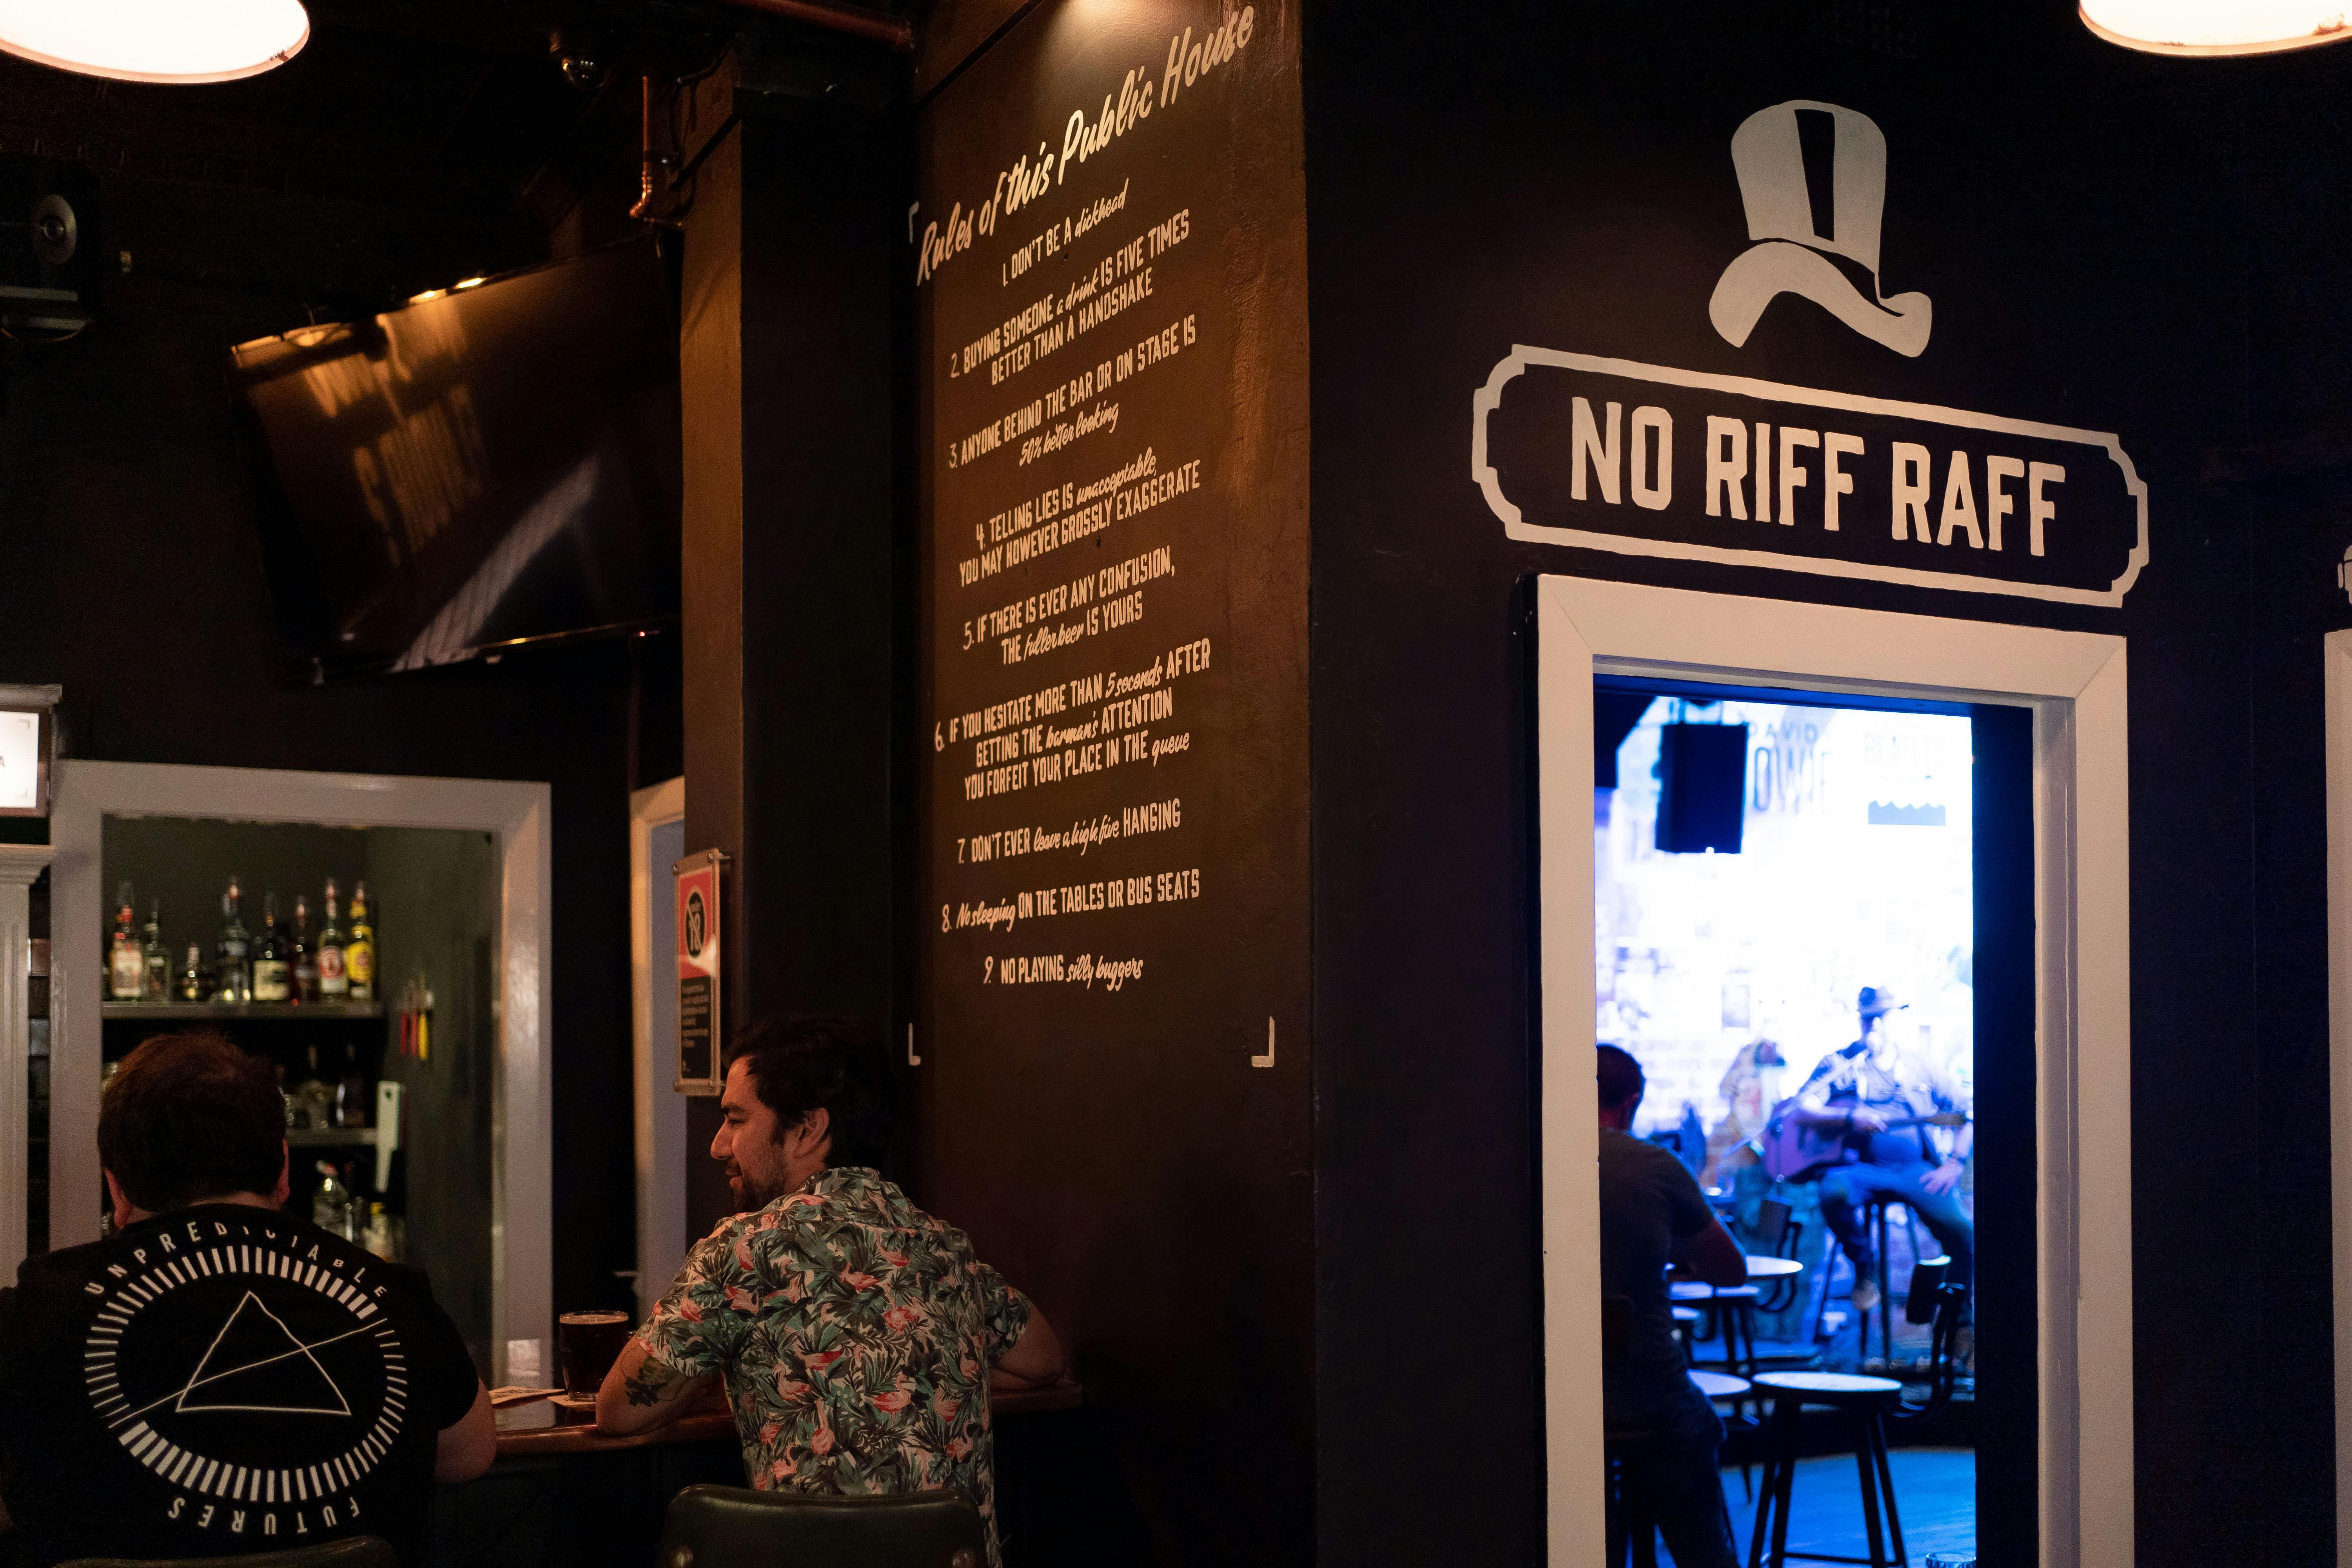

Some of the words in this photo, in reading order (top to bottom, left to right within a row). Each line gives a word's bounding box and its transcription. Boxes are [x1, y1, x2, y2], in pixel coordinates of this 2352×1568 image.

[916, 201, 974, 286] Rules
[978, 171, 1007, 236] of
[1005, 141, 1054, 215] this
[1058, 66, 1152, 185] Public
[1160, 5, 1254, 108] House
[1011, 234, 1044, 279] DON'T
[1046, 223, 1060, 256] BE
[1063, 216, 1071, 245] A
[1074, 177, 1129, 238] dickhead
[963, 327, 1000, 374] BUYING
[1003, 293, 1053, 347] SOMEONE
[1065, 267, 1099, 310] drink
[1100, 256, 1113, 287] IS
[1116, 235, 1144, 277] FIVE
[1147, 208, 1189, 258] TIMES
[991, 342, 1031, 386] BETTER
[1034, 321, 1063, 360] THAN
[1067, 315, 1074, 342] A
[1079, 267, 1152, 334] HANDSHAKE
[961, 419, 1002, 465] ANYONE
[1004, 399, 1042, 442] BEHIND
[1045, 384, 1067, 419] THE
[1070, 371, 1093, 407] BAR
[1097, 360, 1112, 392] OR
[1116, 348, 1133, 382] ON
[1138, 321, 1179, 371] STAGE
[1183, 314, 1196, 346] IS
[1019, 436, 1042, 466] 50%
[1043, 423, 1074, 454] better
[1075, 400, 1119, 438] looking
[989, 500, 1032, 542] TELLING
[1036, 488, 1059, 522] LIES
[1062, 481, 1073, 510] IS
[1572, 397, 1673, 510] NO
[1706, 416, 1864, 531] RIFF
[1892, 441, 2065, 556] RAFF
[959, 557, 978, 587] YOU
[981, 545, 1002, 579] MAY
[1006, 522, 1059, 568] HOWEVER
[1061, 497, 1112, 545] GROSSLY
[1116, 459, 1200, 521] EXAGGERATE
[963, 621, 975, 650] 5.
[977, 613, 987, 642] IF
[989, 601, 1023, 637] THERE
[1025, 596, 1036, 623] IS
[1039, 584, 1067, 619] EVER
[1070, 573, 1095, 608] ANY
[1099, 544, 1175, 597] CONFUSION,
[1001, 635, 1022, 665] THE
[1086, 606, 1098, 636] IS
[1102, 590, 1143, 632] YOURS
[949, 717, 959, 743] IF
[962, 711, 981, 739] YOU
[984, 694, 1032, 732] HESITATE
[1035, 683, 1066, 717] MORE
[1070, 672, 1102, 707] THAN
[1115, 655, 1163, 697] seconds
[1166, 637, 1210, 679] AFTER
[976, 732, 1018, 768] GETTING
[1022, 724, 1043, 754] THE
[1045, 710, 1098, 748] barman's
[1101, 686, 1172, 734] ATTENTION
[964, 772, 984, 800] YOU
[987, 761, 1028, 796] FORFEIT
[1033, 754, 1061, 786] YOUR
[1065, 742, 1102, 777] PLACE
[1106, 737, 1119, 768] IN
[1123, 730, 1148, 762] THE
[1151, 732, 1190, 767] queue
[971, 831, 1002, 863] DON'T
[1004, 827, 1030, 857] EVER
[1033, 826, 1061, 852] leave
[1123, 797, 1181, 837] HANGING
[970, 897, 1016, 932] sleeping
[1018, 891, 1033, 919] ON
[1035, 888, 1057, 916] THE
[1060, 882, 1104, 913] TABLES
[1107, 879, 1124, 908] OR
[1127, 875, 1152, 906] BUS
[1157, 868, 1200, 902] SEATS
[1000, 957, 1016, 984] NO
[1018, 954, 1064, 983] PLAYING
[1065, 953, 1094, 989] silly
[1095, 955, 1143, 991] buggers
[168, 1497, 359, 1535] FUTURES
